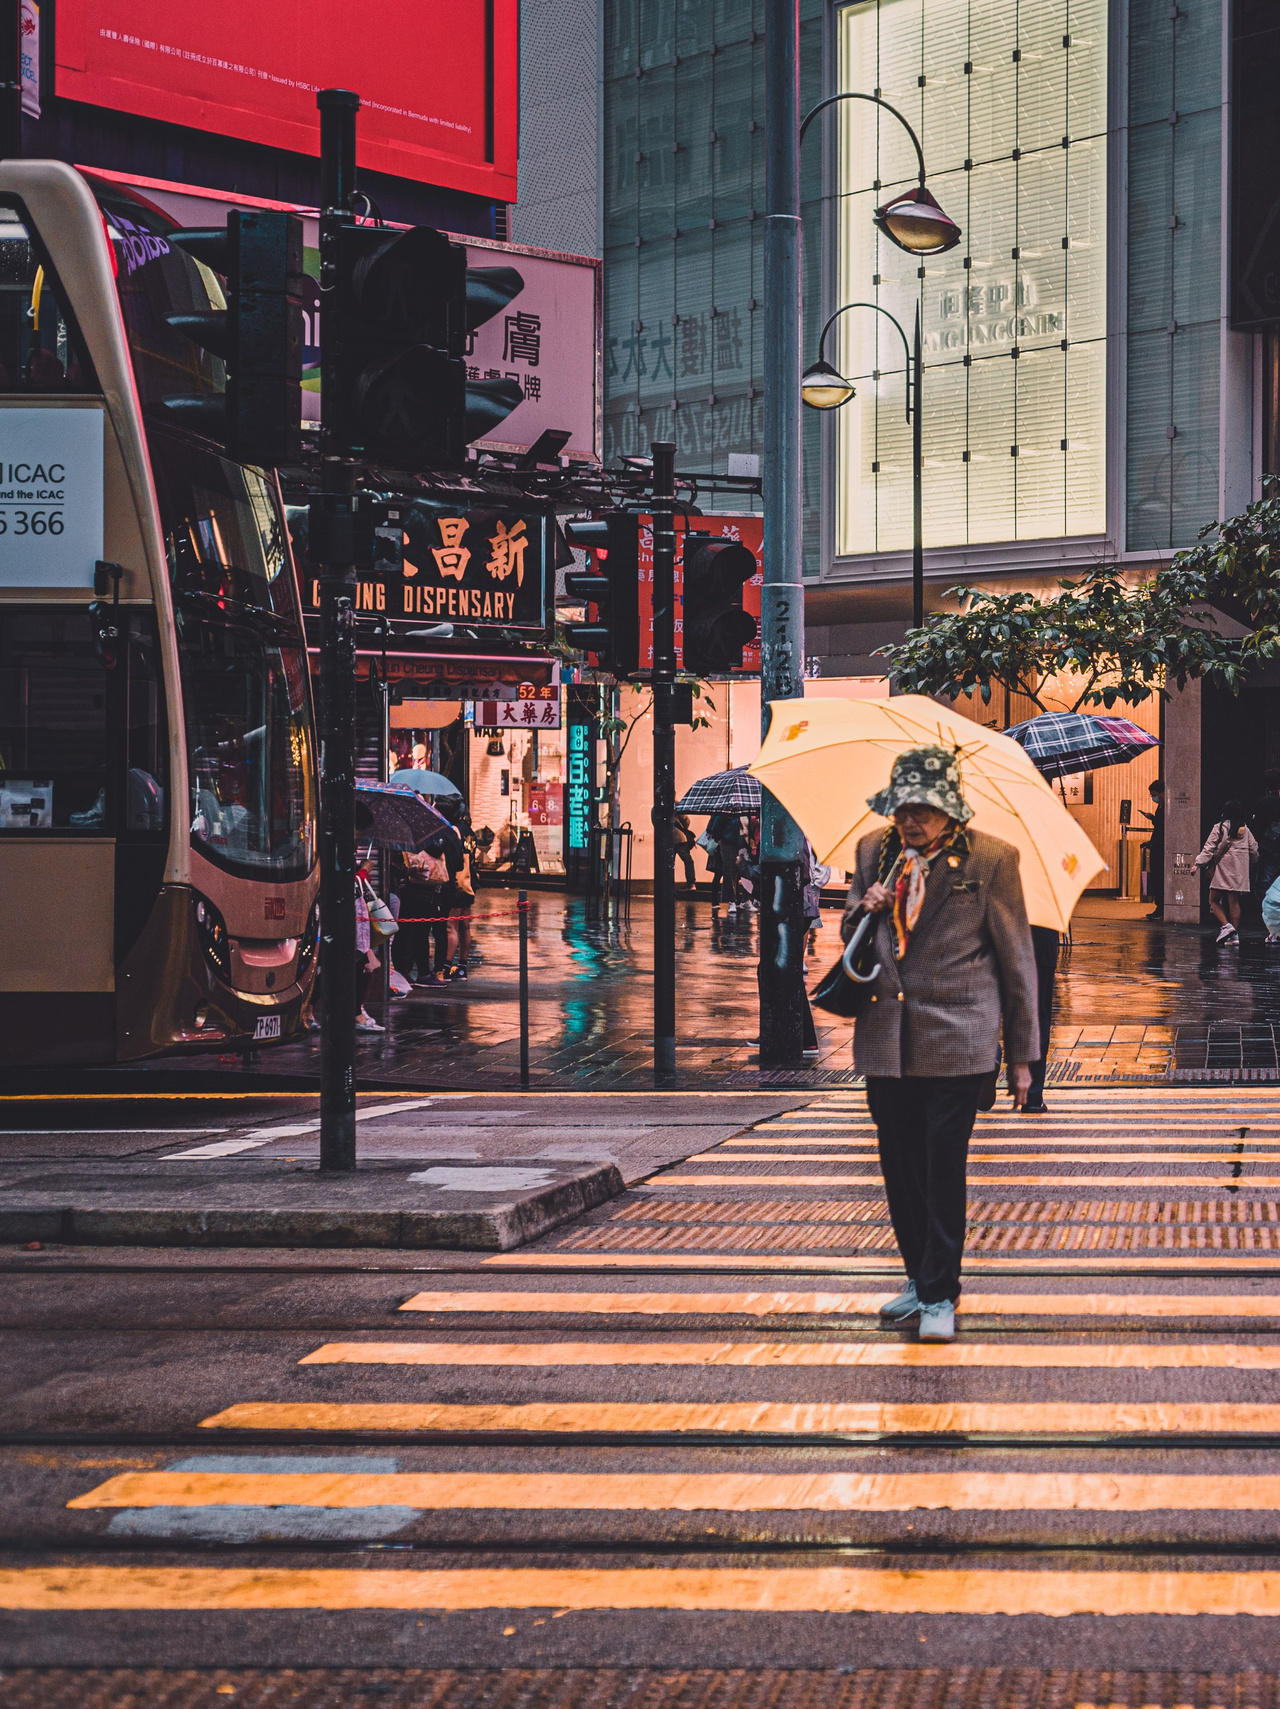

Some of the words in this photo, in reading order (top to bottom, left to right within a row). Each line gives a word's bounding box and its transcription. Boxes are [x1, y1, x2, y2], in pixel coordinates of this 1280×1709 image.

[271, 76, 288, 86] Issued
[289, 79, 295, 88] by
[296, 81, 310, 92] HSBC
[408, 110, 428, 123] Bermuda
[429, 116, 439, 124] with
[440, 118, 454, 129] limited
[9, 464, 65, 483] ICAC
[0, 490, 14, 499] nd
[17, 490, 33, 499] the
[37, 490, 64, 499] ICAC
[312, 580, 385, 610] CNG
[404, 585, 515, 620] DISPENSARY
[403, 662, 444, 677] Cheung
[519, 686, 535, 698] 52
[540, 687, 551, 698] 年
[502, 703, 557, 725] 大藥房
